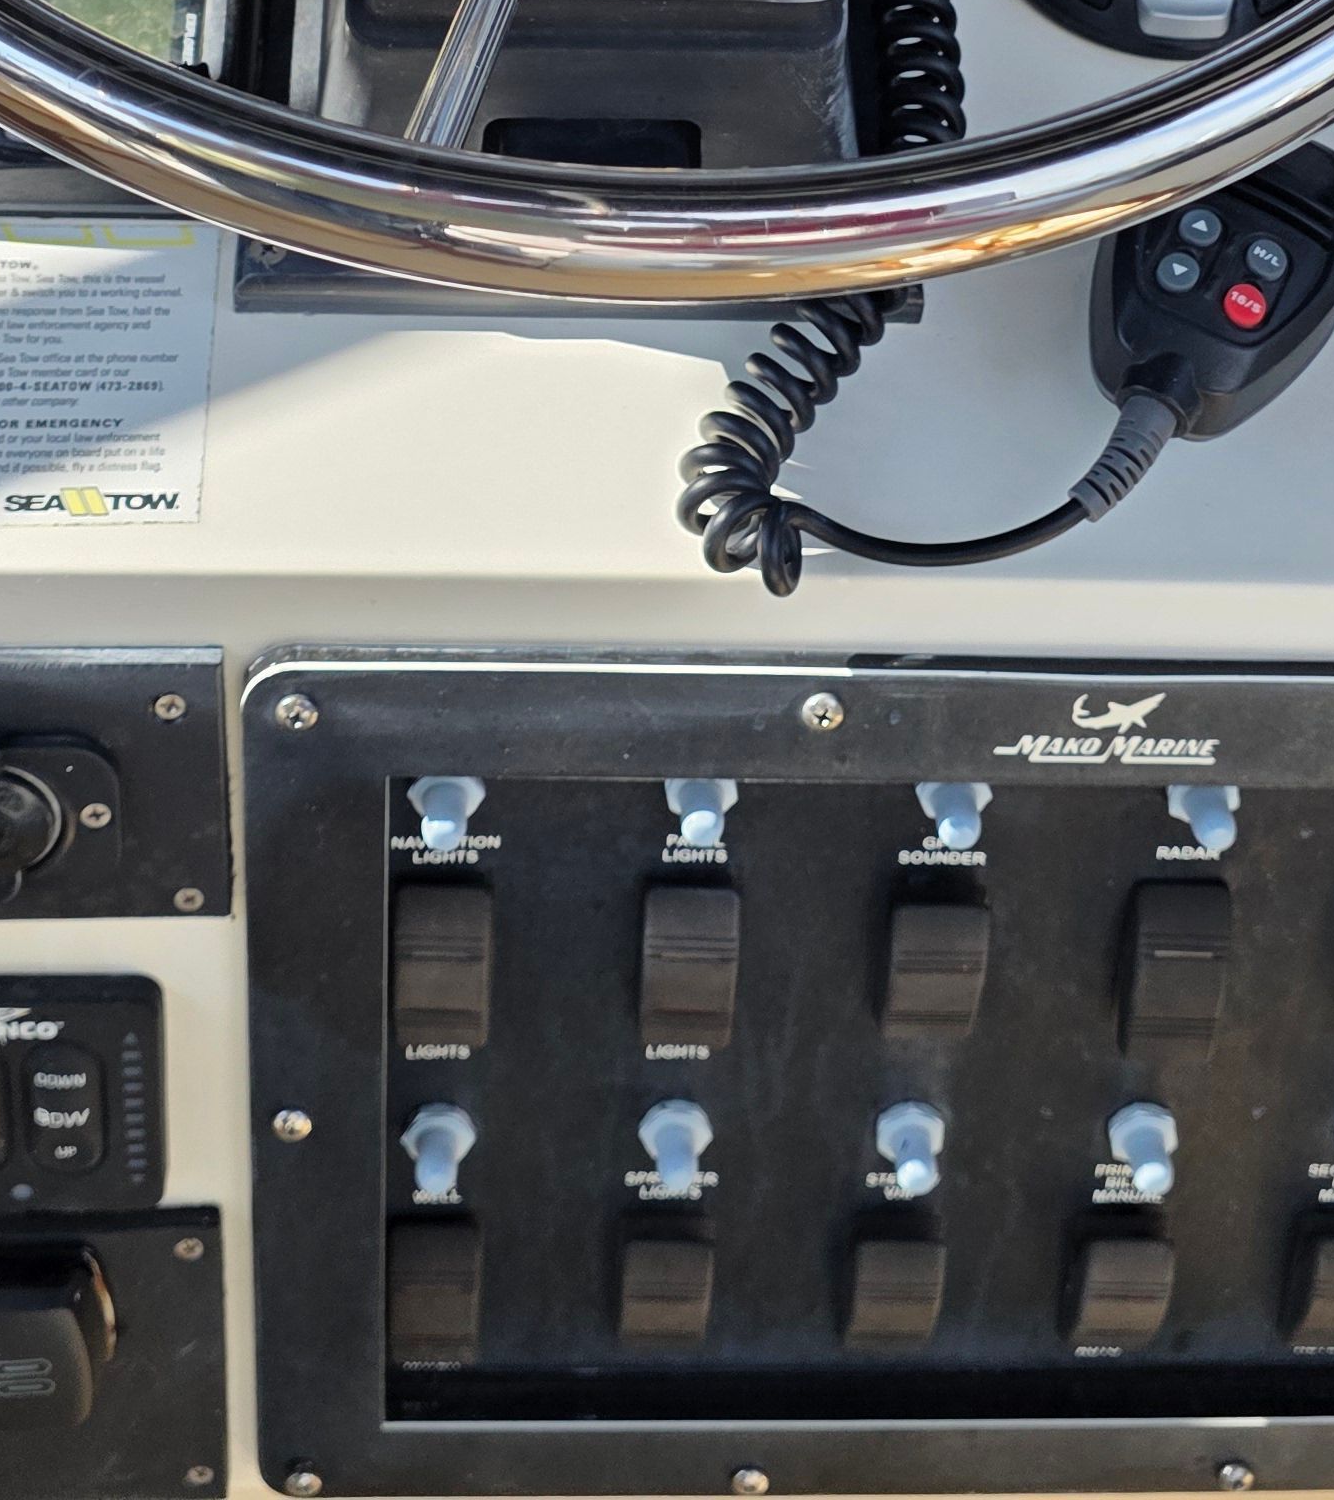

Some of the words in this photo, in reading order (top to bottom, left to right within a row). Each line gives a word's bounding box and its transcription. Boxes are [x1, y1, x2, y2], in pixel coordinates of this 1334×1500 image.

[100, 288, 140, 299] working
[60, 306, 83, 316] from
[86, 306, 105, 316] Sea
[154, 306, 170, 316] the
[28, 320, 92, 330] enforcement
[94, 321, 129, 331] agency
[132, 320, 151, 329] and
[20, 353, 40, 363] Tow
[87, 353, 104, 363] the
[106, 353, 138, 364] phone
[140, 353, 179, 363] number
[25, 418, 124, 429] EMERGENCY
[20, 435, 43, 445] your
[46, 433, 71, 444] local
[74, 433, 93, 443] law
[95, 432, 160, 443] enforcement
[5, 450, 53, 460] everyone
[4, 493, 64, 512] SEA
[1001, 734, 1104, 762] MAKO
[1105, 735, 1221, 764] MARINE
[391, 835, 502, 851] NAVTION
[412, 849, 479, 865] LIGHTS
[661, 848, 729, 864] LIGHTS
[898, 849, 988, 867] SOUNDER
[1156, 845, 1222, 862] RADAR
[404, 1044, 471, 1061] LIGHTS
[644, 1043, 711, 1061] LIGHTS
[33, 1071, 87, 1088] DOWN
[33, 1106, 91, 1130] BOW
[54, 1144, 78, 1160] UP
[623, 1170, 720, 1188] SPRER
[1091, 1187, 1165, 1205] MANUAL
